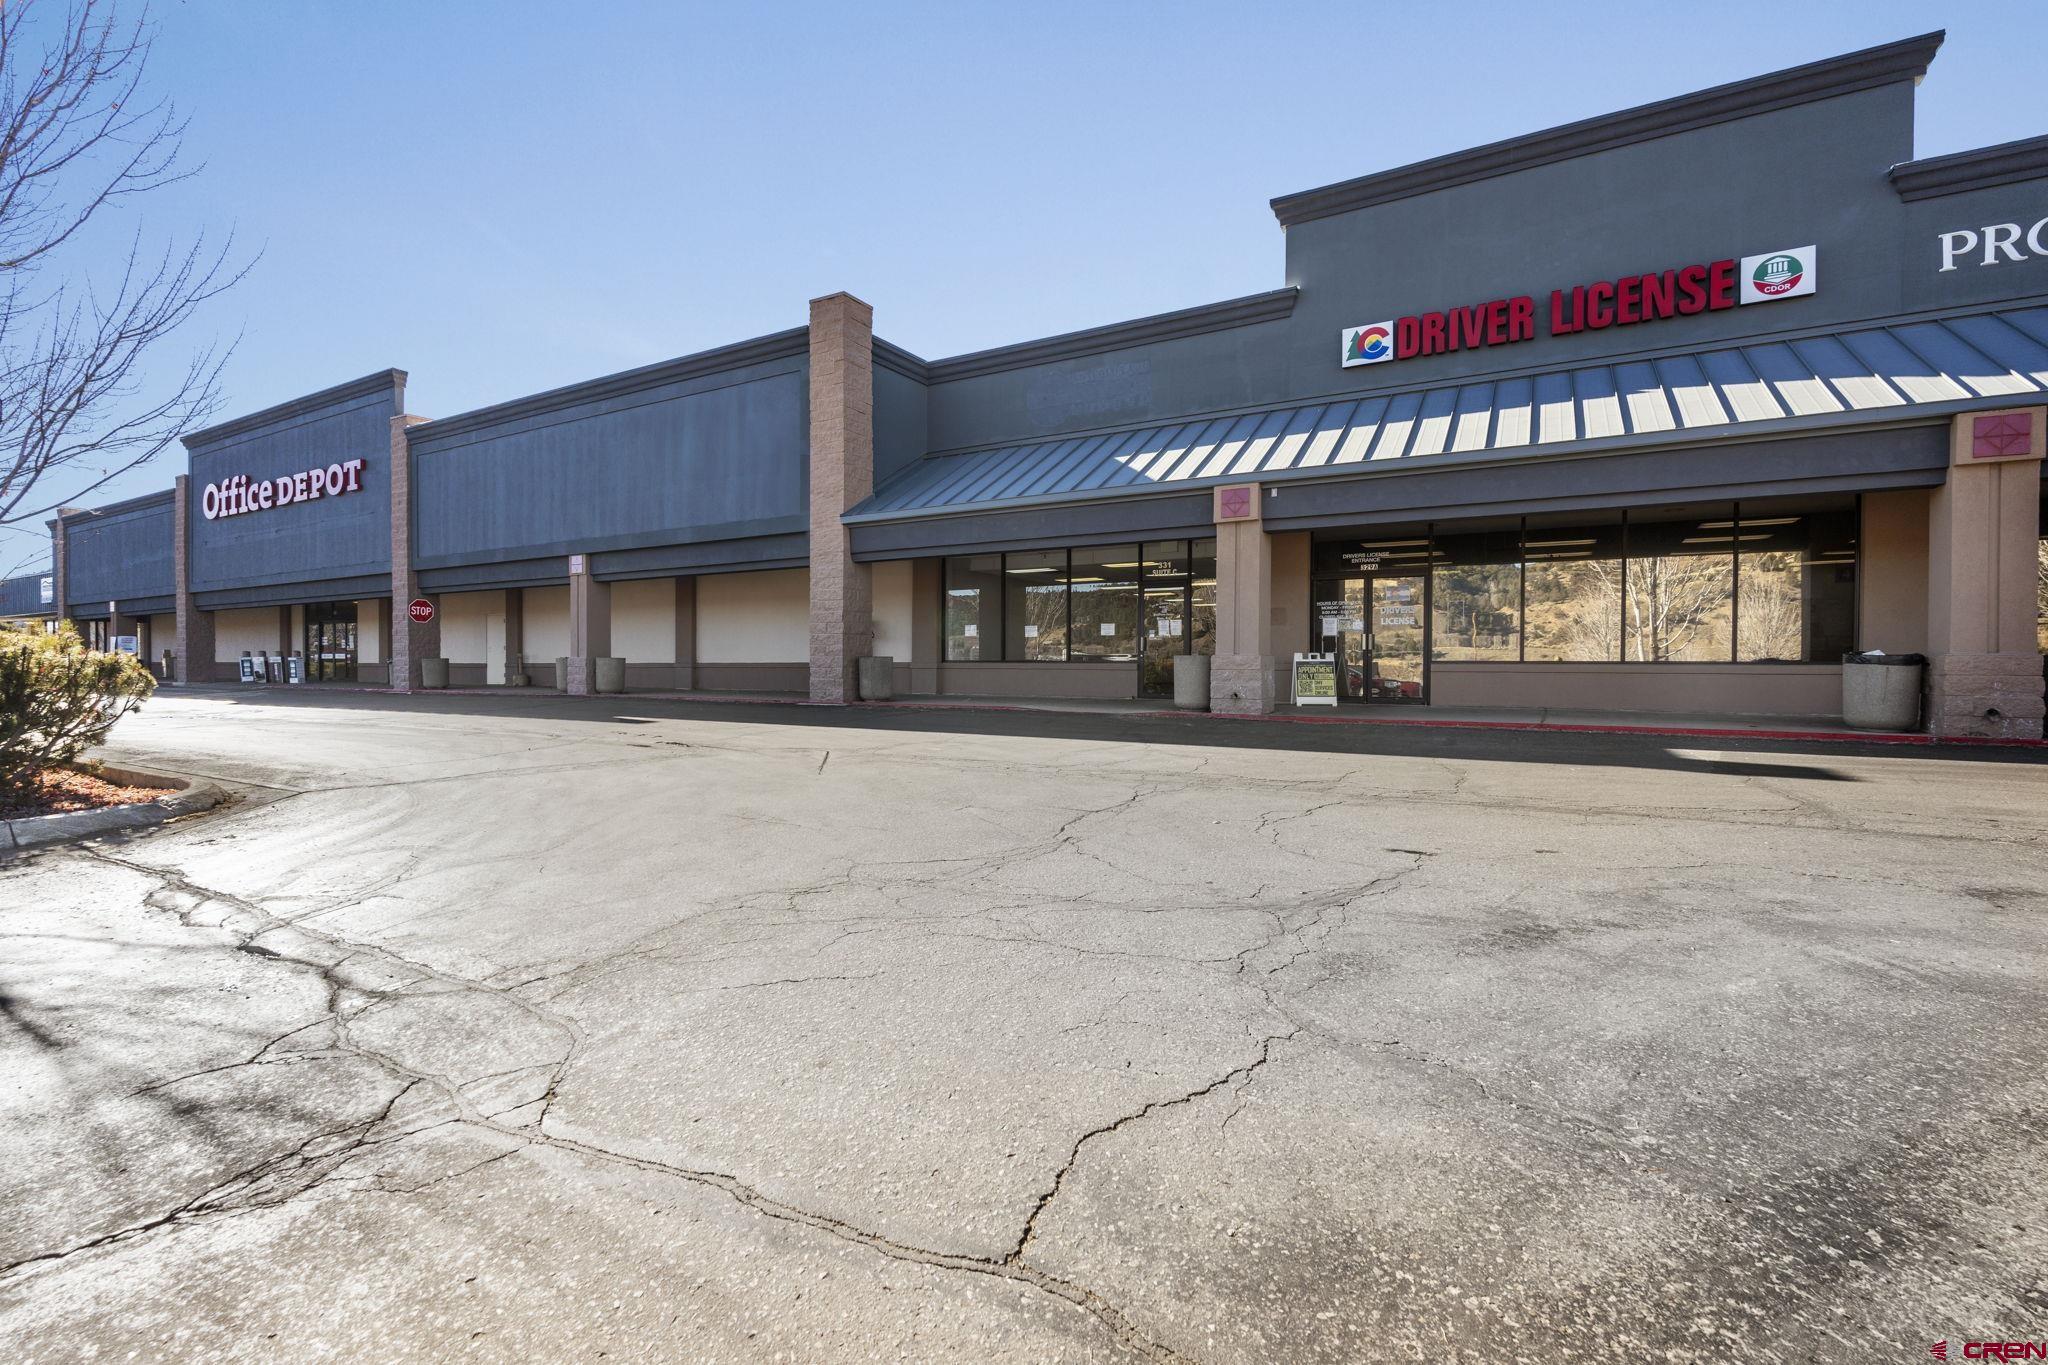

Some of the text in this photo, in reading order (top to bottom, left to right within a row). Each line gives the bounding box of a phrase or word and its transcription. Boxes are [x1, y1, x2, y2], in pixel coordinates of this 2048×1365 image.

[1764, 283, 1791, 293] CDOR
[1397, 259, 1736, 361] DRIVER LICENSE
[202, 458, 362, 520] Office DEPOT
[1158, 561, 1172, 569] 331
[410, 606, 432, 616] STOP
[1380, 606, 1416, 615] DRIVERS
[1380, 616, 1416, 625] LICENSE
[1298, 665, 1334, 673] APPOINTMENT
